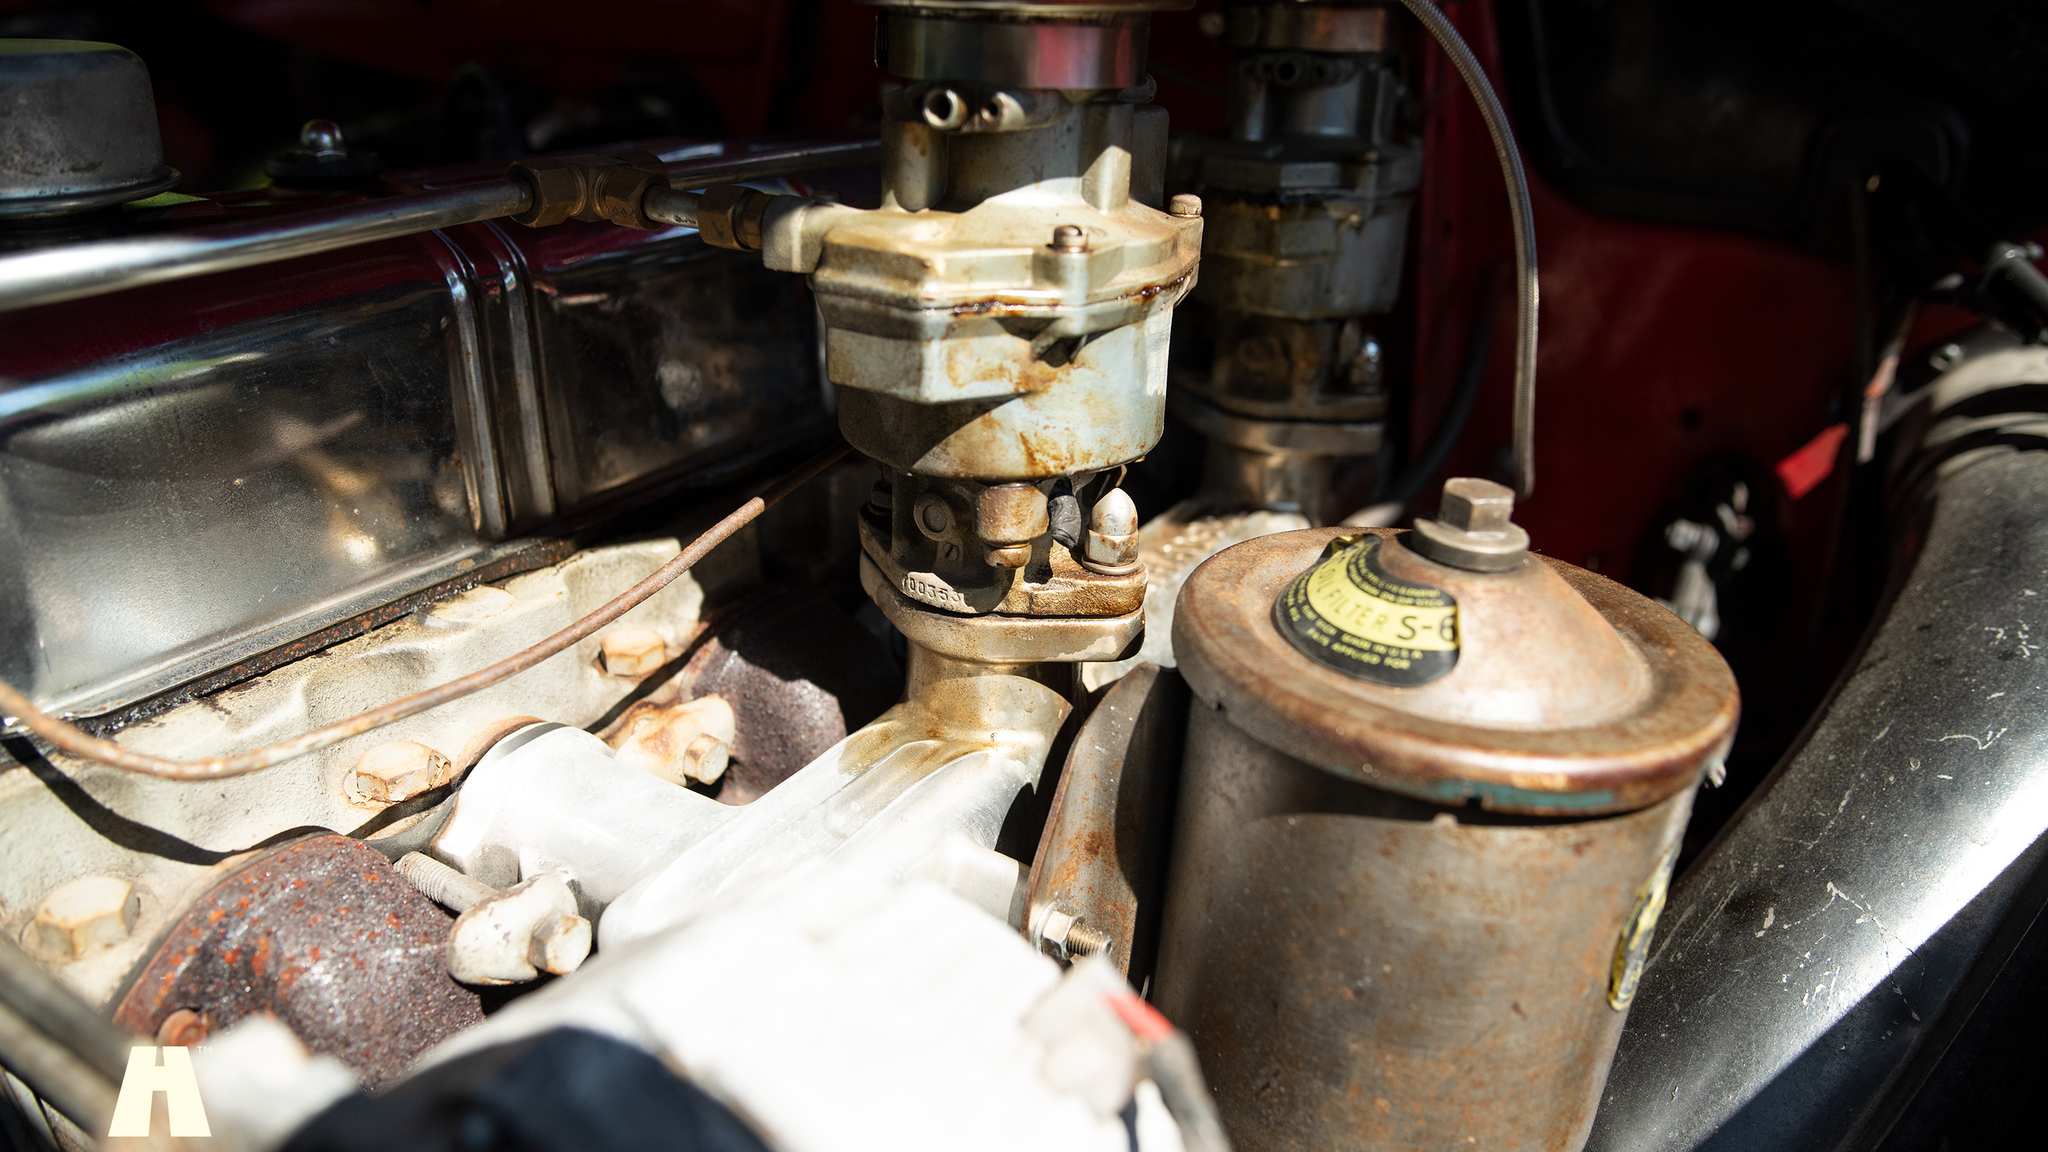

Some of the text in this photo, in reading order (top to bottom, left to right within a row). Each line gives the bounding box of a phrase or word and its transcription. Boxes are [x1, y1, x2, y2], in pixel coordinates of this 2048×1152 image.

[1316, 568, 1336, 593] OIL
[1321, 587, 1389, 632] FILTER
[1330, 642, 1381, 665] APPLIED
[1383, 656, 1411, 670] FOR
[1340, 632, 1372, 651] MADE
[1372, 643, 1388, 655] IN
